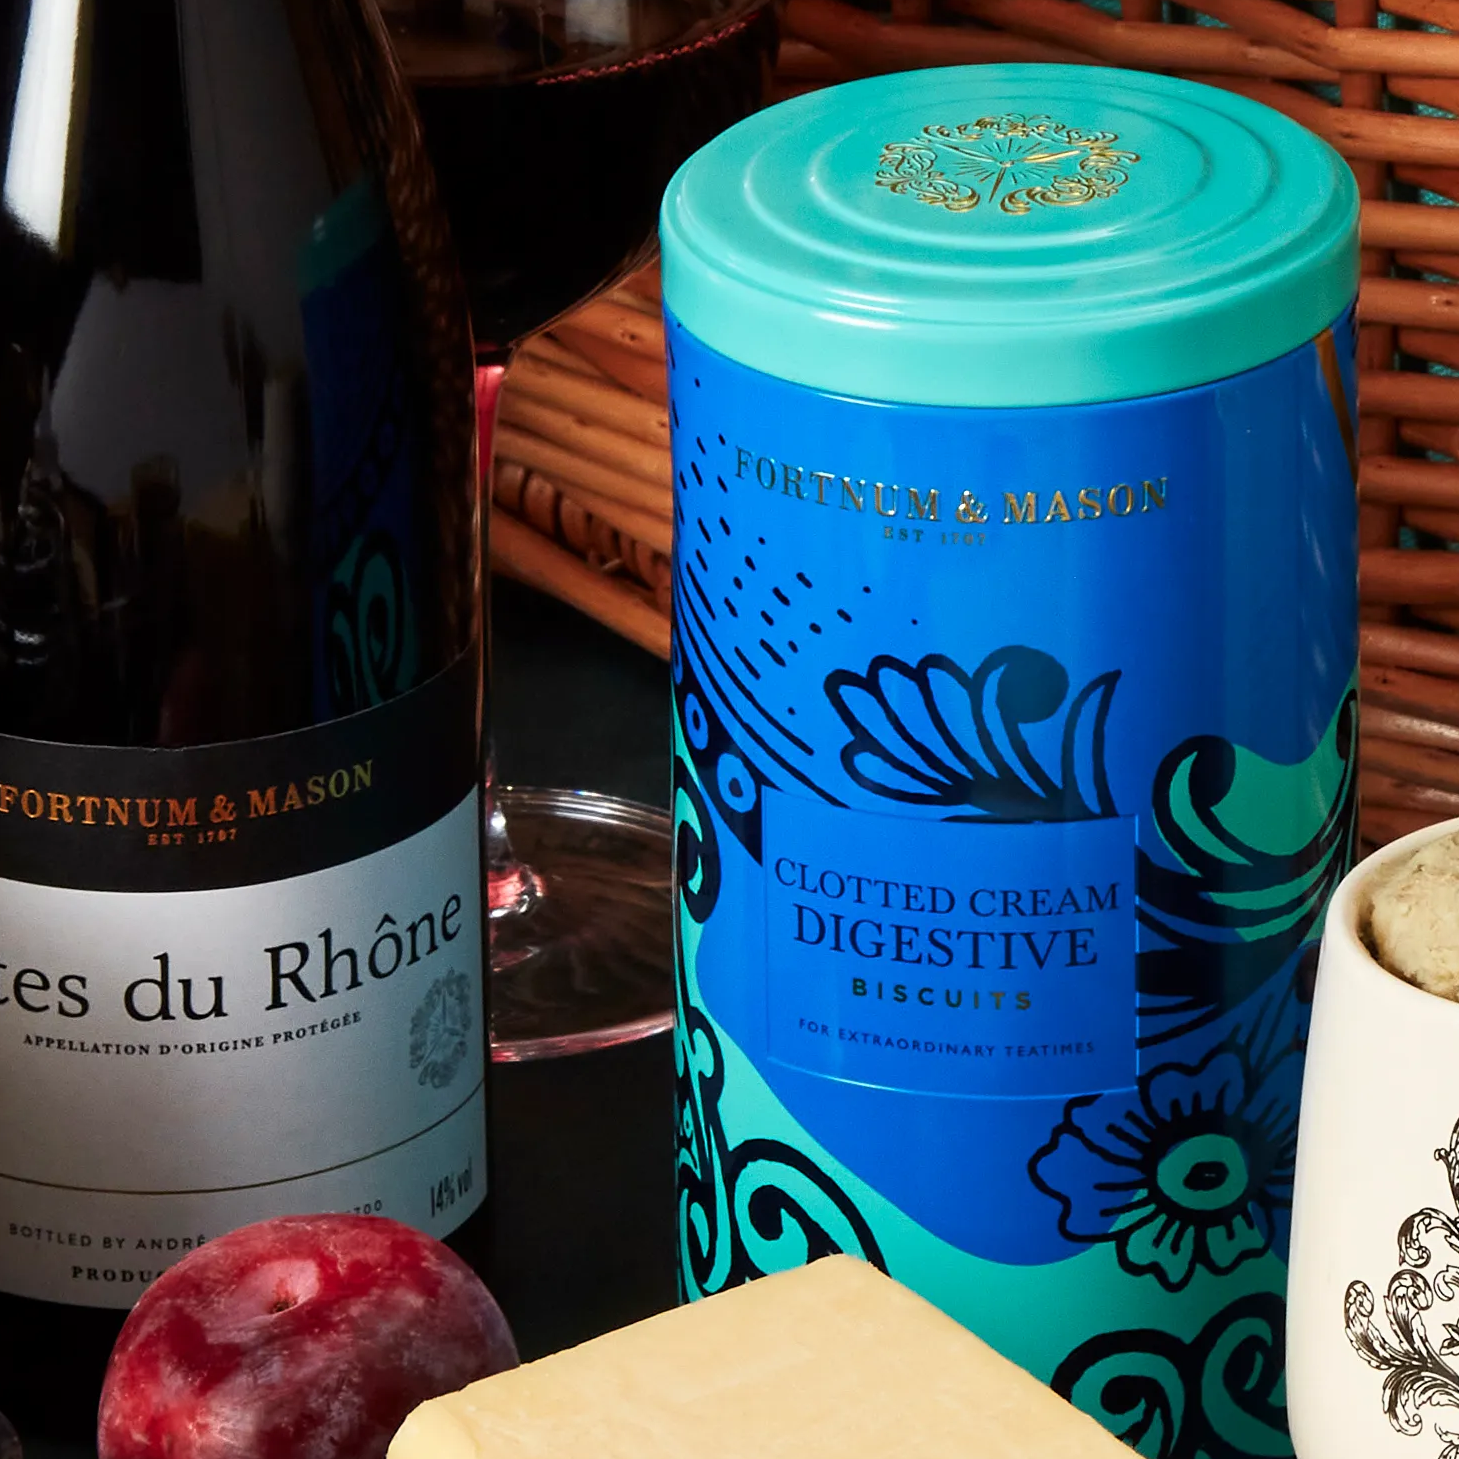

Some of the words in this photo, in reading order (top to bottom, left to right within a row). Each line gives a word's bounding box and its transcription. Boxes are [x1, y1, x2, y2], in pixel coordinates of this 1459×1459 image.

[733, 445, 942, 523] FORTNUM
[954, 489, 990, 525] &
[1003, 477, 1172, 525] MASON
[208, 794, 237, 823] &
[246, 760, 375, 818] MASON
[775, 857, 957, 915] CLOTTED
[969, 882, 1122, 919] CREAM
[123, 952, 229, 1022] du
[264, 892, 463, 1013] Rhône
[792, 903, 1099, 970] DIGESTIVE
[851, 977, 1033, 1011] BISCUITS
[23, 1033, 152, 1056] APPELLATION
[271, 1009, 363, 1044] PROTÉGÉE
[798, 1019, 832, 1038] FOR
[838, 1027, 997, 1058] EXTRAORDINARY
[1004, 1042, 1096, 1057] TEATIMES
[8, 1222, 92, 1250] BOTTLED
[102, 1234, 127, 1250] BY
